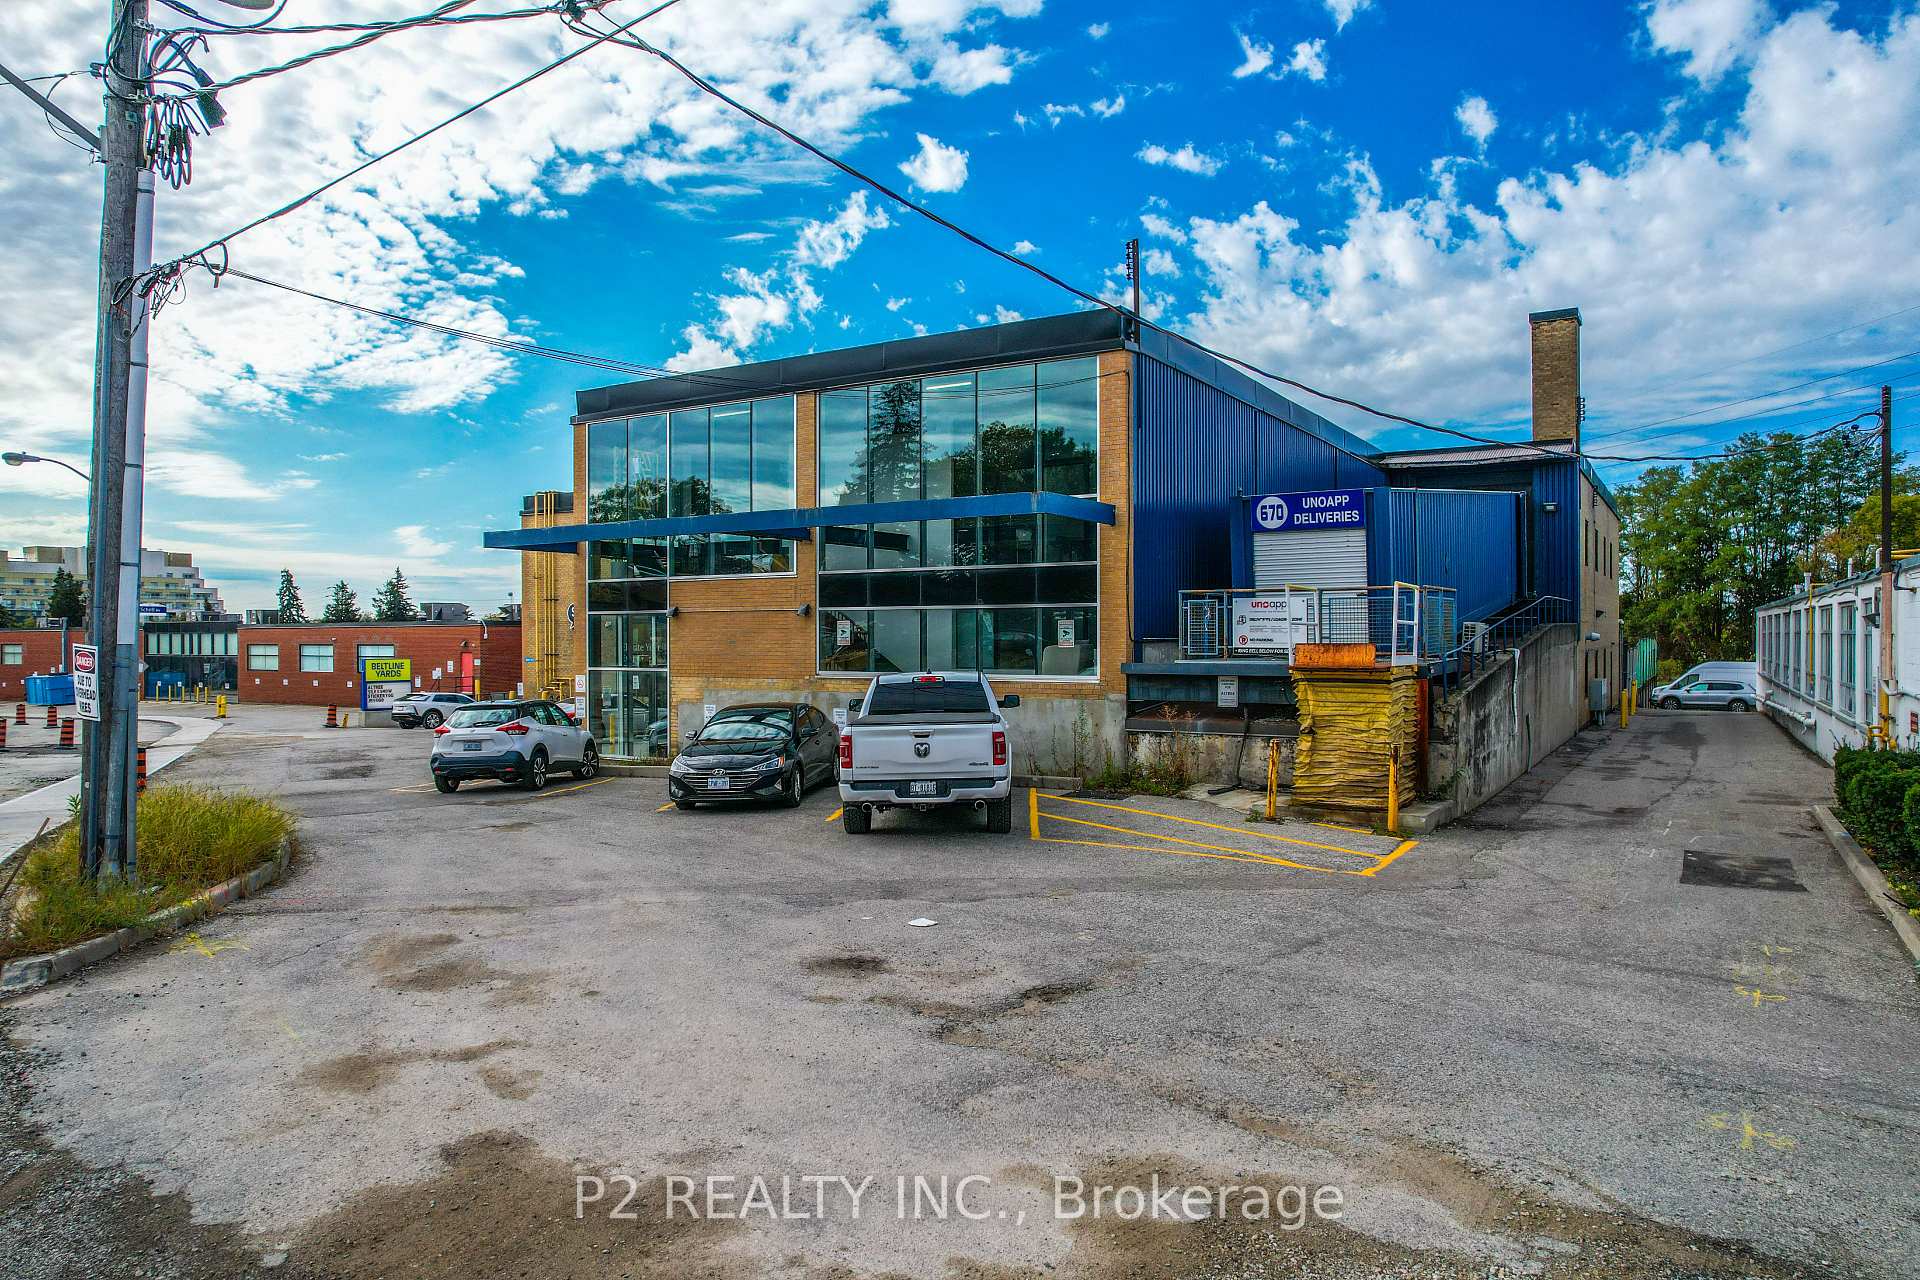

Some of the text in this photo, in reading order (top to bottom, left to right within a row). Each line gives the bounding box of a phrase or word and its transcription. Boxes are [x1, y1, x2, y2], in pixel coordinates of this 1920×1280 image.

[1302, 495, 1350, 508] UNOAPP
[1260, 504, 1283, 521] 670
[1294, 510, 1360, 525] DELIVERIES
[1251, 601, 1287, 610] unoapp
[76, 656, 93, 667] DANGER
[371, 662, 404, 670] BELTLINE
